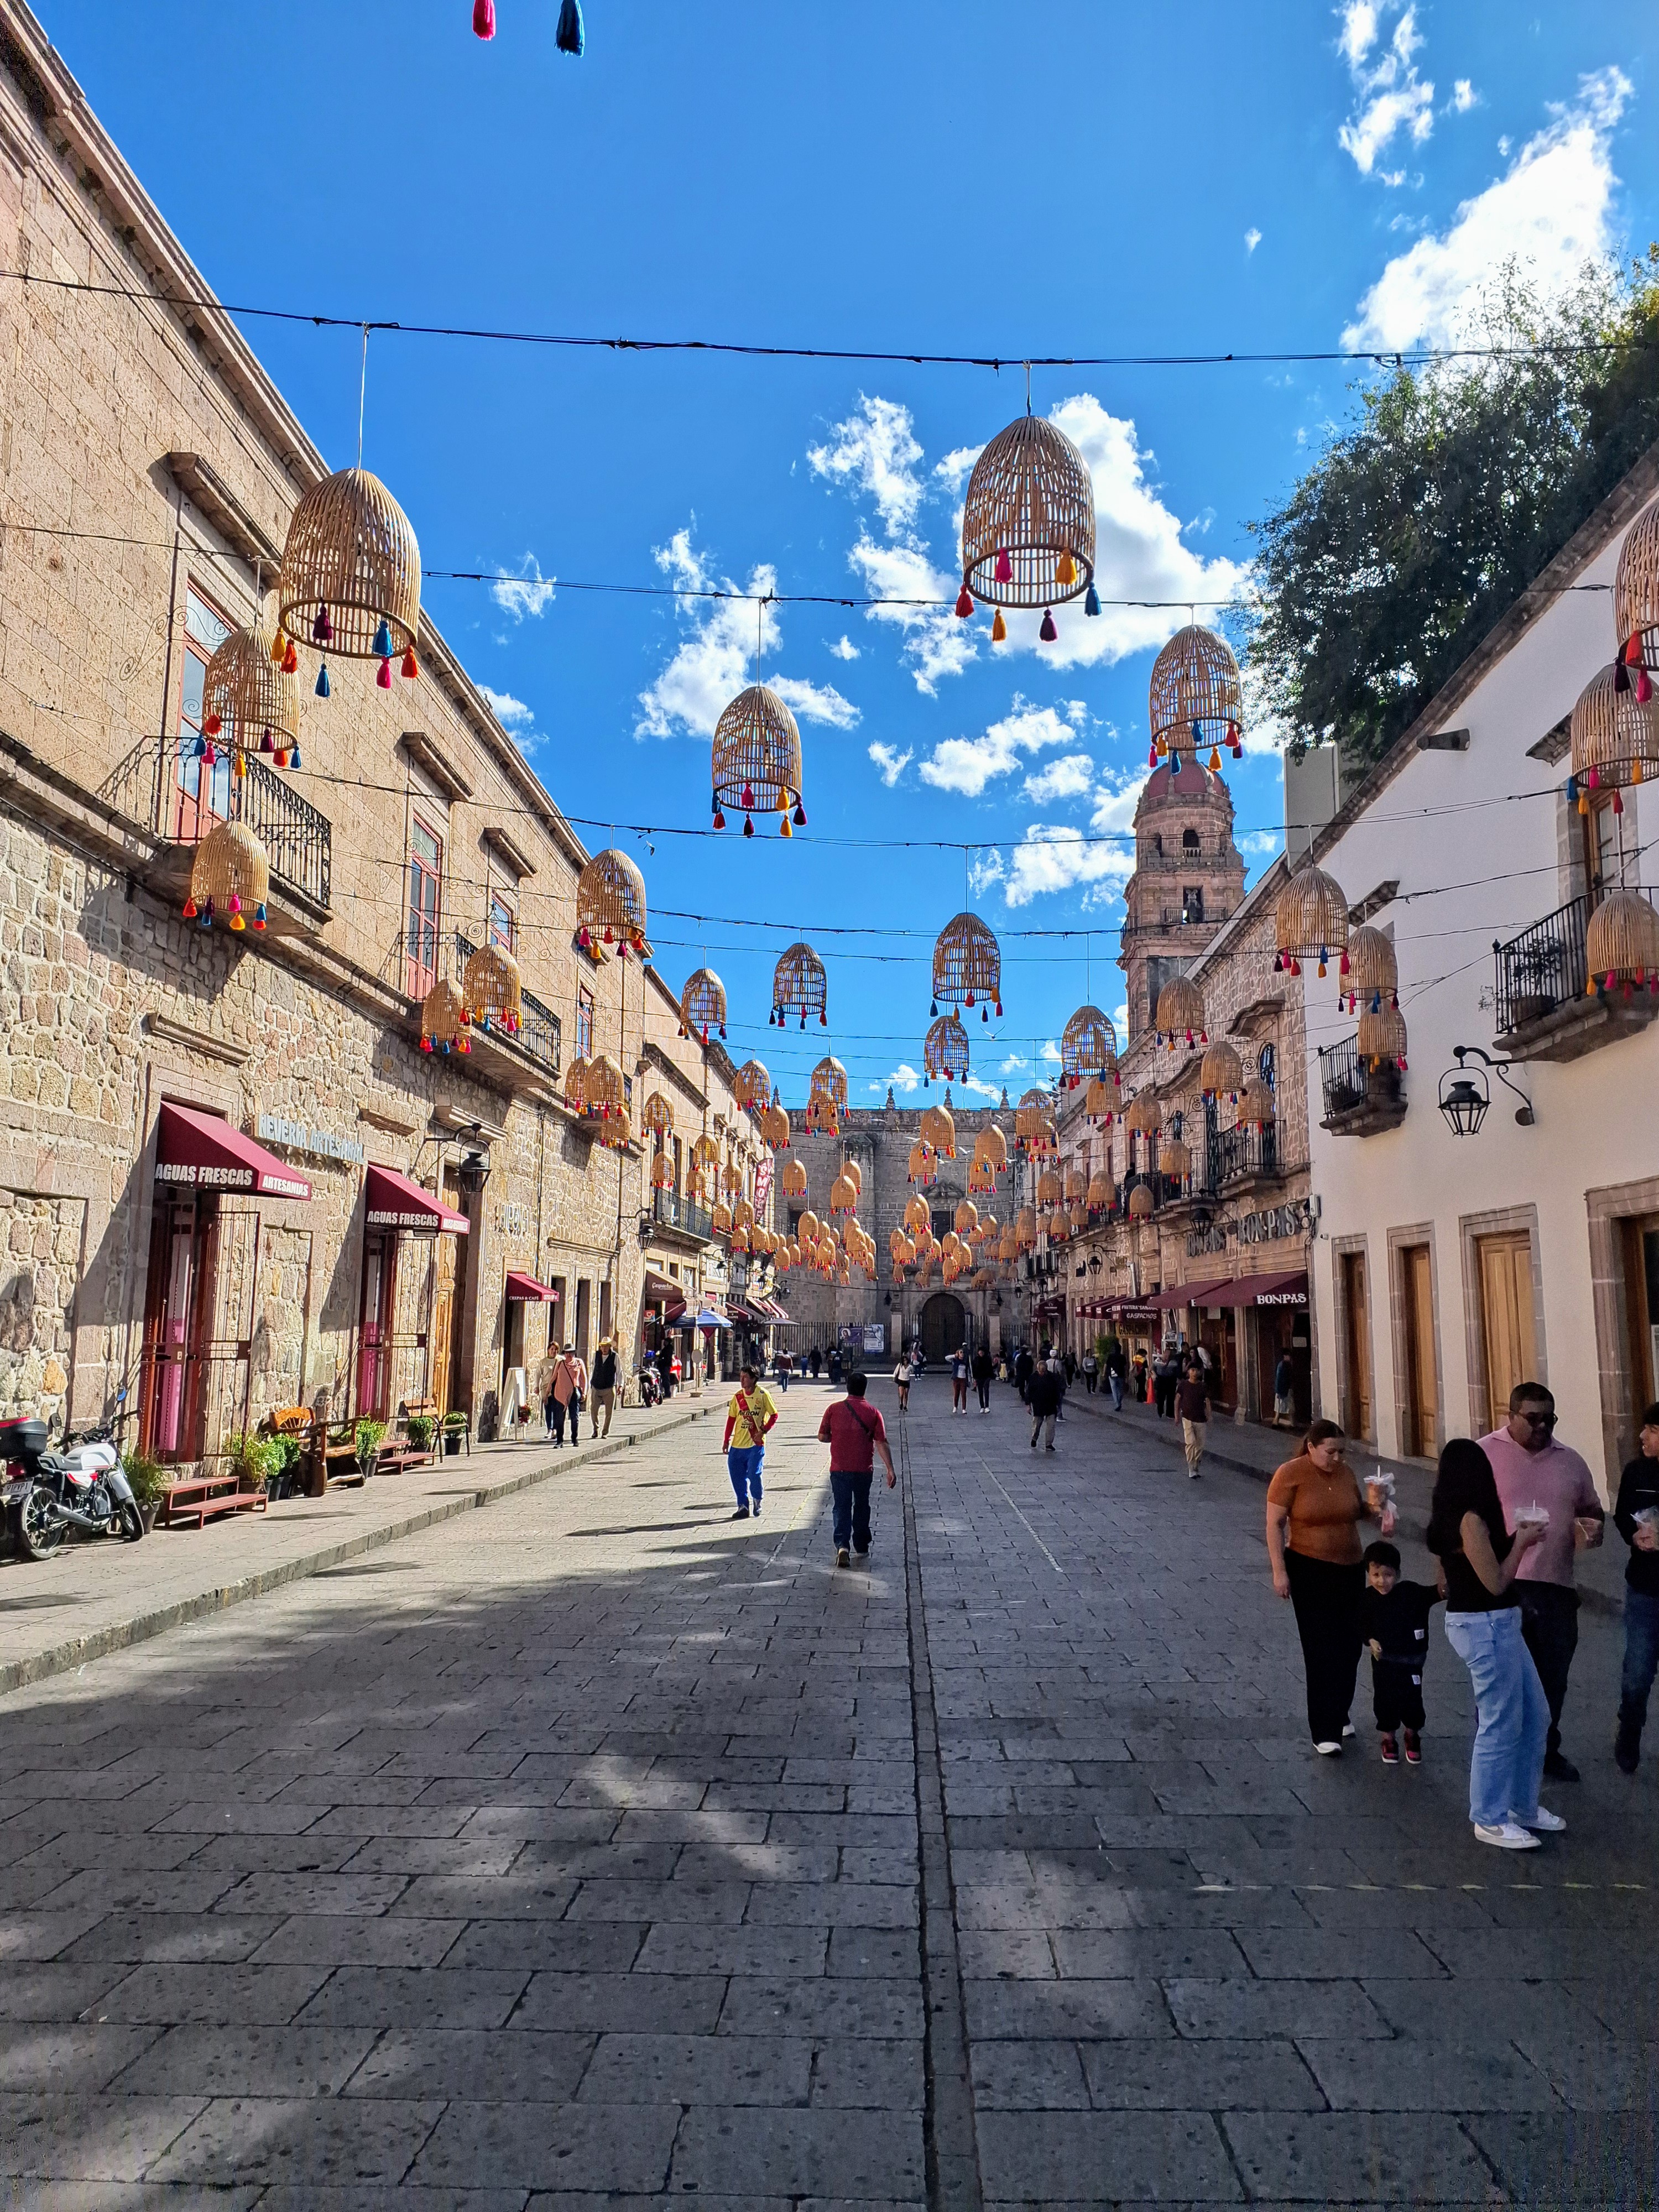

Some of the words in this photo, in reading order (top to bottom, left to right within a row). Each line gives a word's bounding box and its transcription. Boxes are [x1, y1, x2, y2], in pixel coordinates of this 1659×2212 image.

[310, 1129, 366, 1165] ARTESANAL
[155, 1164, 196, 1182] AGUAS
[198, 1166, 253, 1186] FRESCAS
[262, 1175, 309, 1197] ARTESANIAS
[367, 1211, 398, 1224] AGUAS
[399, 1213, 439, 1227] FRESCAS
[1256, 1293, 1307, 1305] BONPAS
